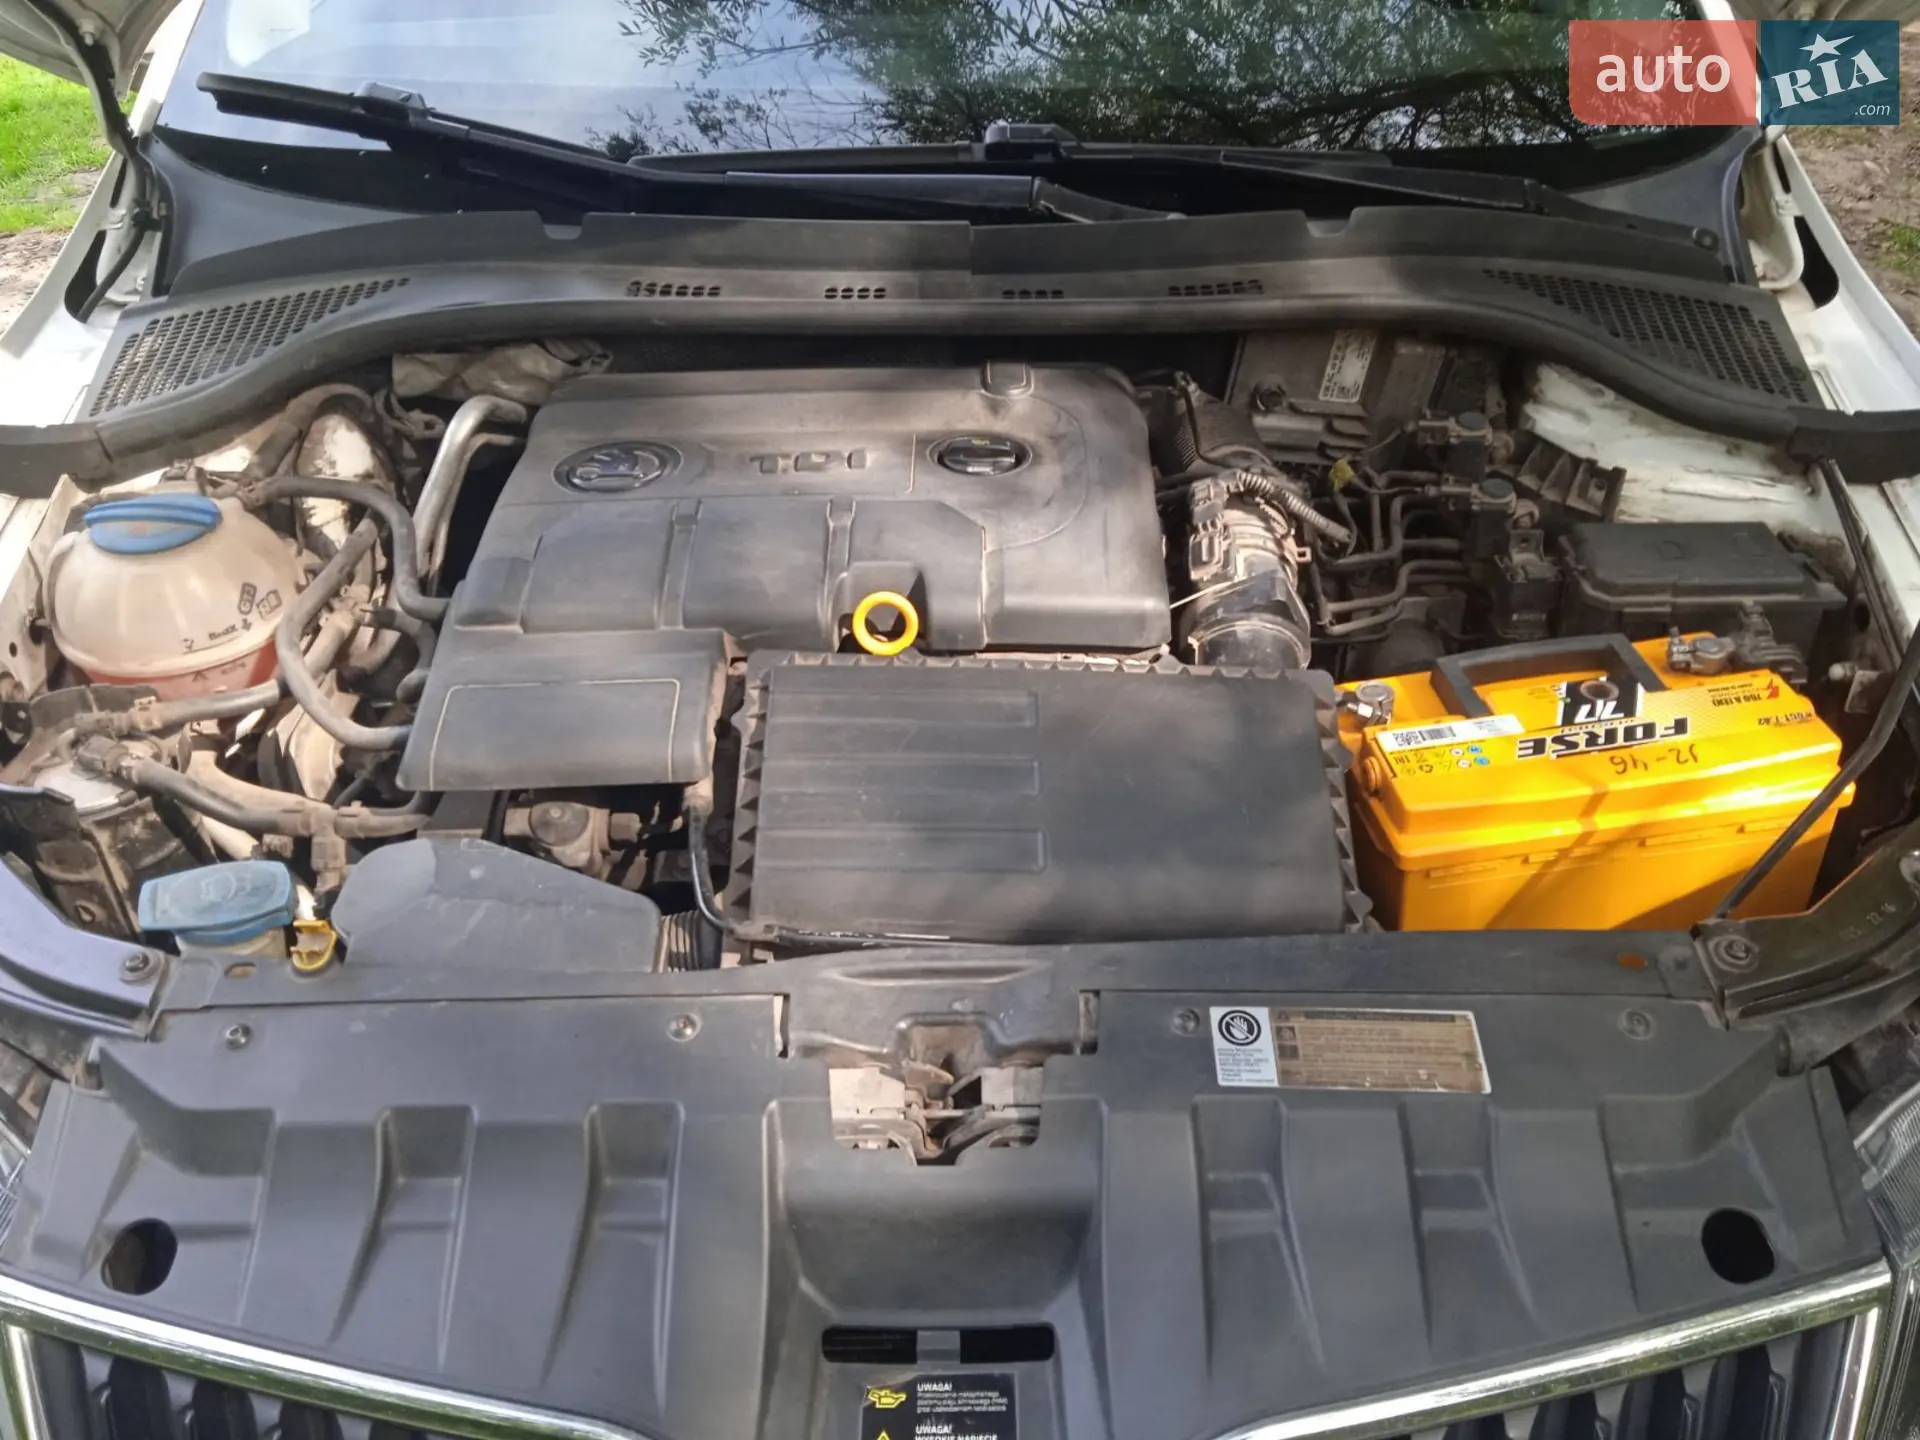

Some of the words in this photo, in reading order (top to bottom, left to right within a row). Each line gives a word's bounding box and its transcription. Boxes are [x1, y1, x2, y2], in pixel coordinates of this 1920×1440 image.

[750, 449, 868, 474] TDI
[1518, 718, 1688, 758] FORSE
[917, 1383, 953, 1392] UWAGA!
[915, 1424, 953, 1434] UWAGA!
